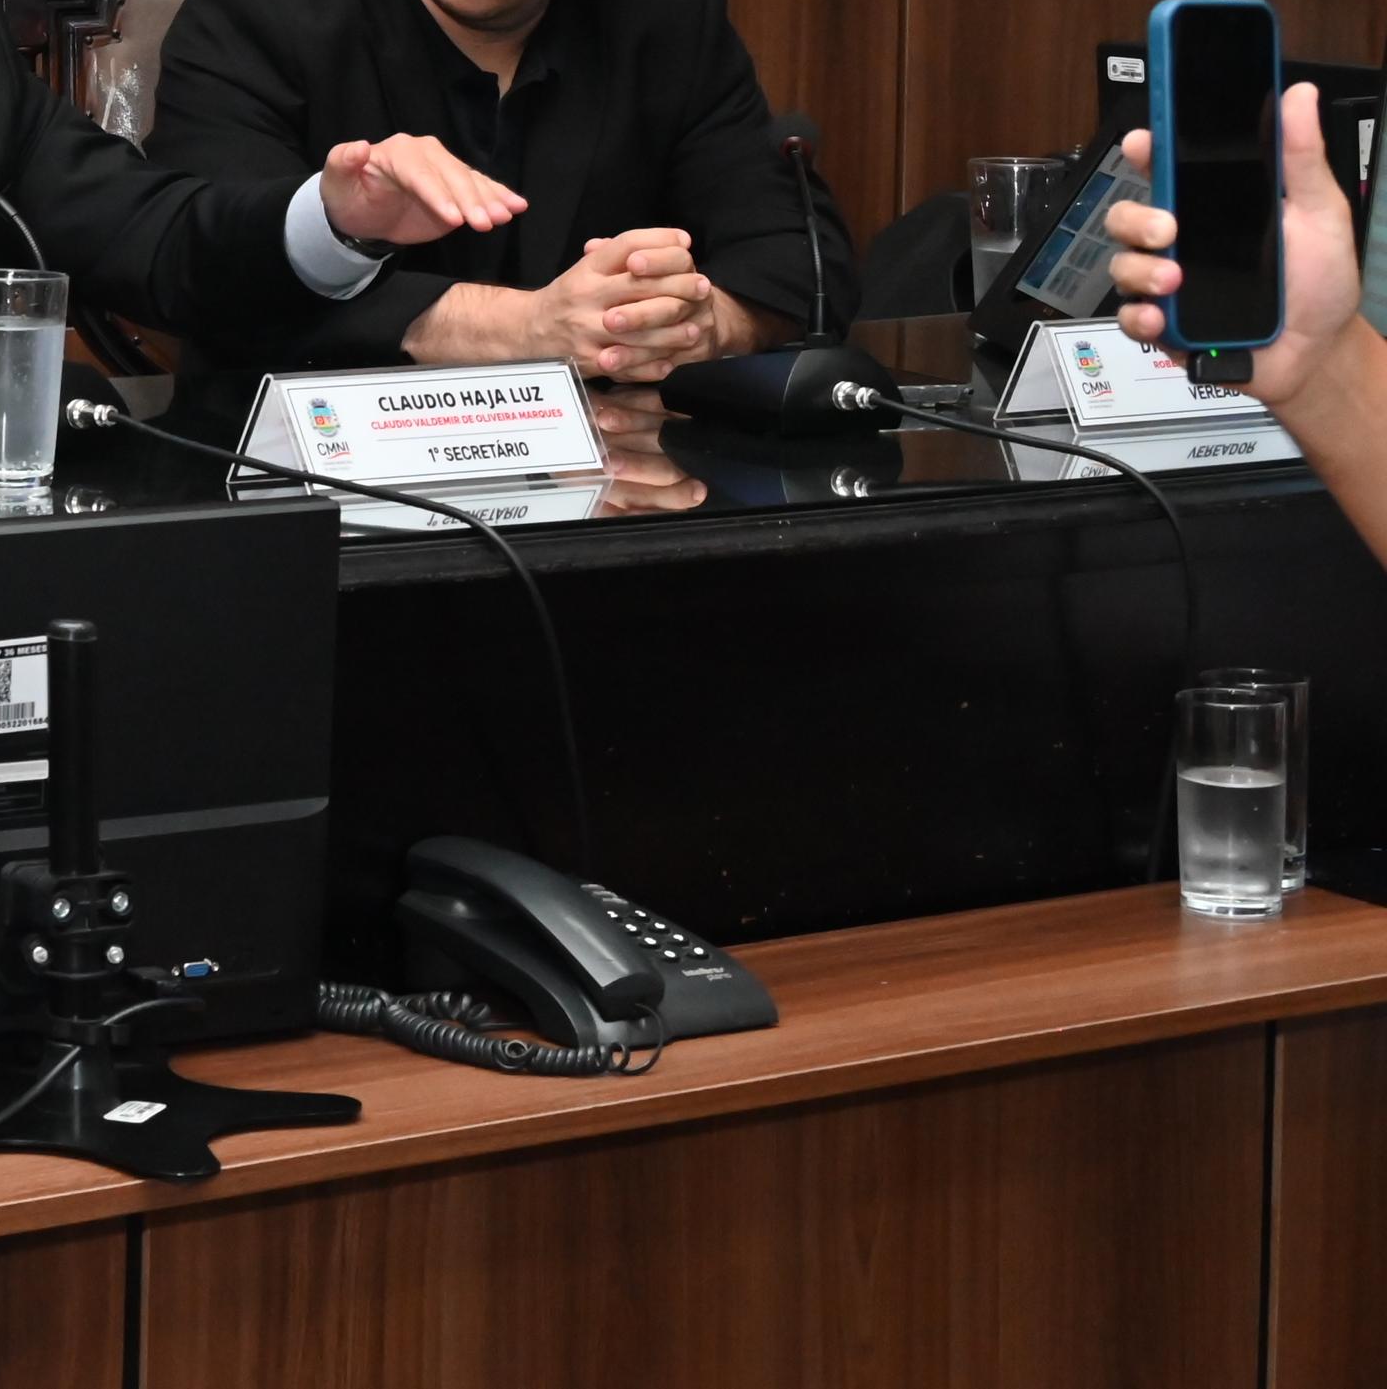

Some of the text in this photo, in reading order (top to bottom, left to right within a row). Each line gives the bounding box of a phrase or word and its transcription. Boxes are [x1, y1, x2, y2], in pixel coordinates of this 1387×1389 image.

[1082, 381, 1112, 395] CMNI
[378, 386, 544, 412] CLAUDIO HAJA LUZ
[371, 409, 563, 430] CLAUDIO VALDEMIR DE OLIVEIRA MARQUES
[316, 441, 350, 456] CMNI
[443, 439, 530, 462] SECRETÁRIO
